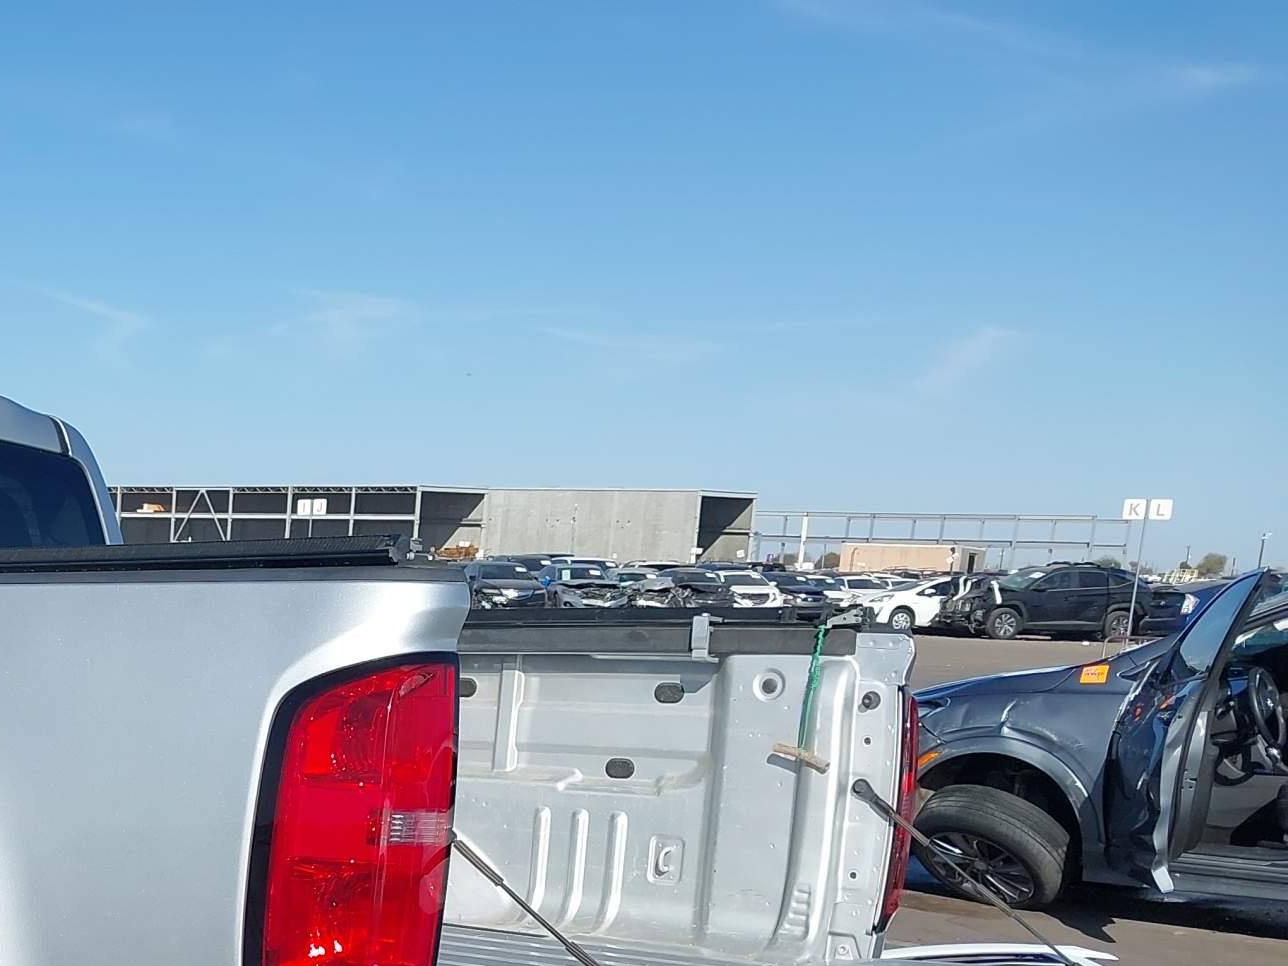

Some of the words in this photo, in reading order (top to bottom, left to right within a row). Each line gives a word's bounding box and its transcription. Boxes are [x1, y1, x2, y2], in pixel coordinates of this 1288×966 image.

[316, 501, 323, 513] J
[1128, 503, 1140, 516] K
[1156, 503, 1165, 516] L
